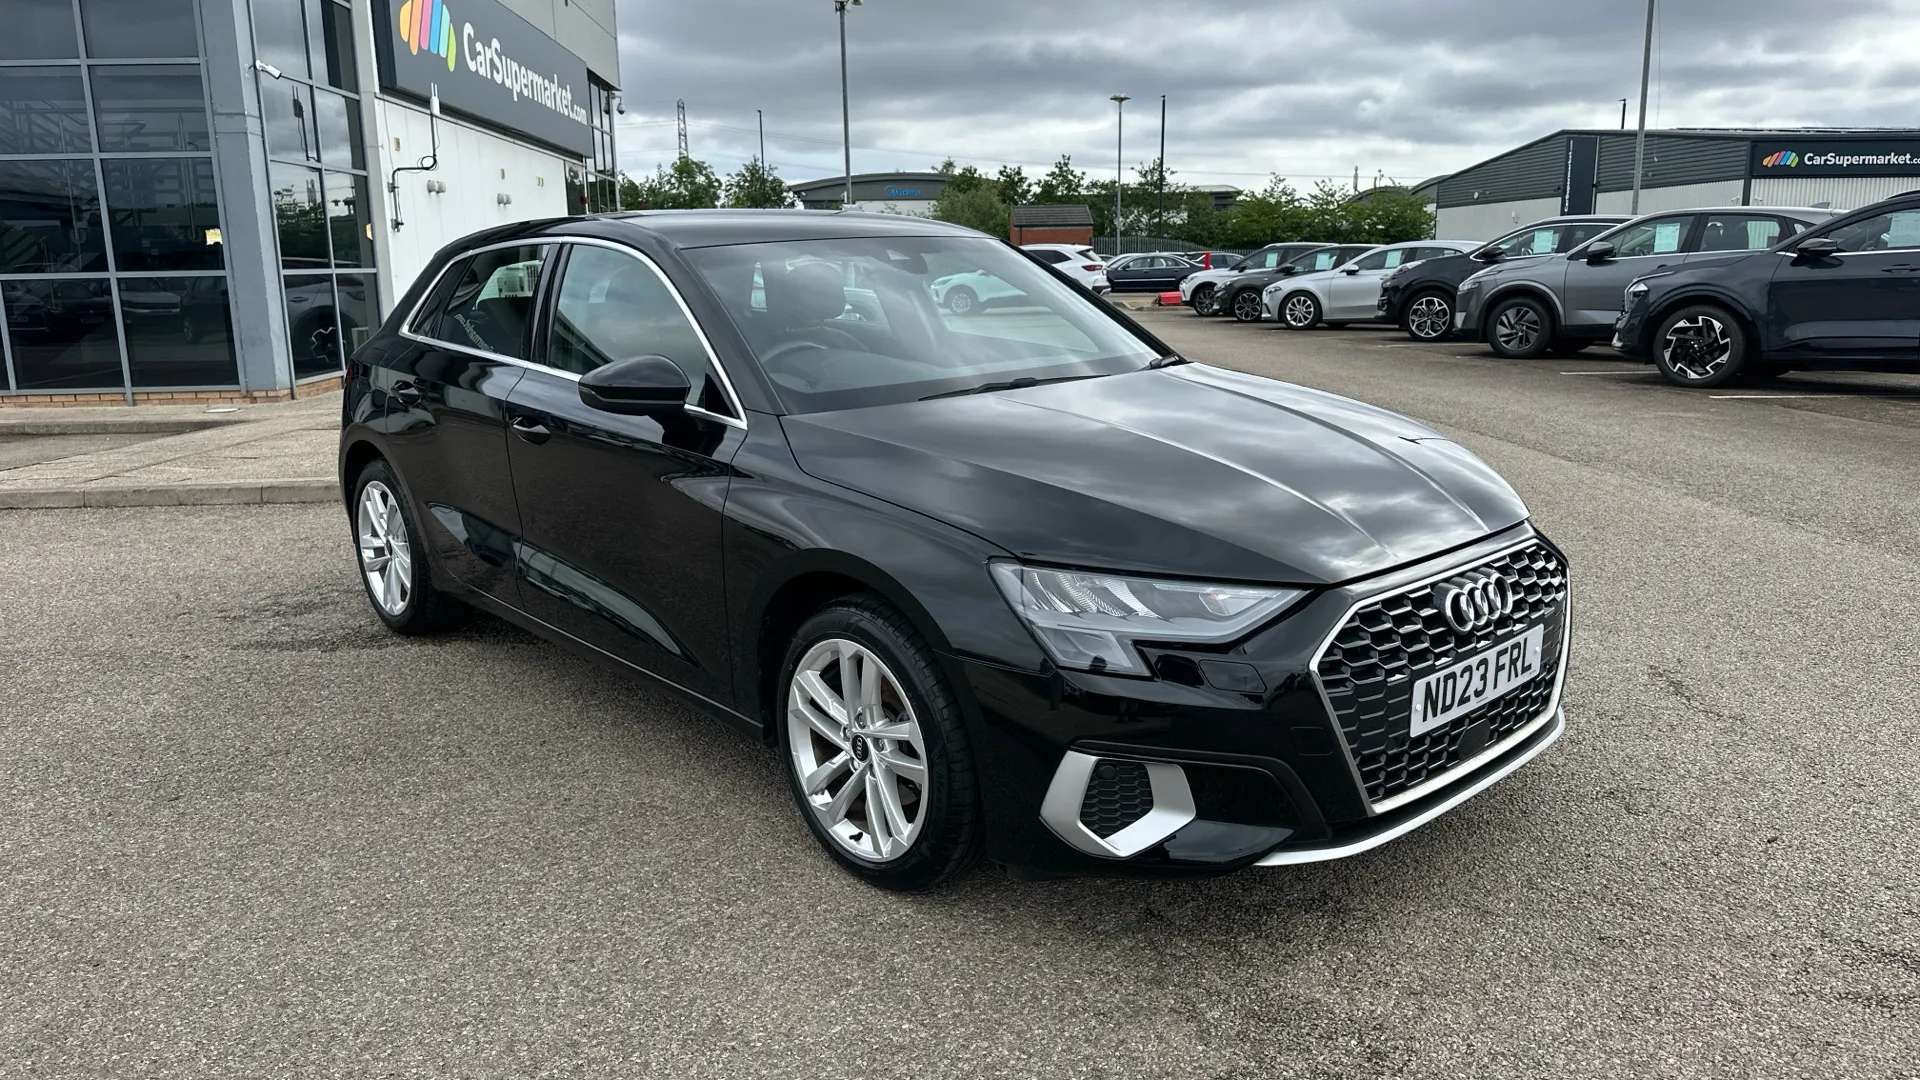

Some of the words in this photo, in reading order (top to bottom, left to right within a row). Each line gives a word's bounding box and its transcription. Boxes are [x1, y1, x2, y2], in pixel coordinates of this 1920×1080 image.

[463, 22, 587, 125] CarSupermarket.com
[1422, 657, 1489, 722] ND23
[1493, 637, 1532, 690] FRL
